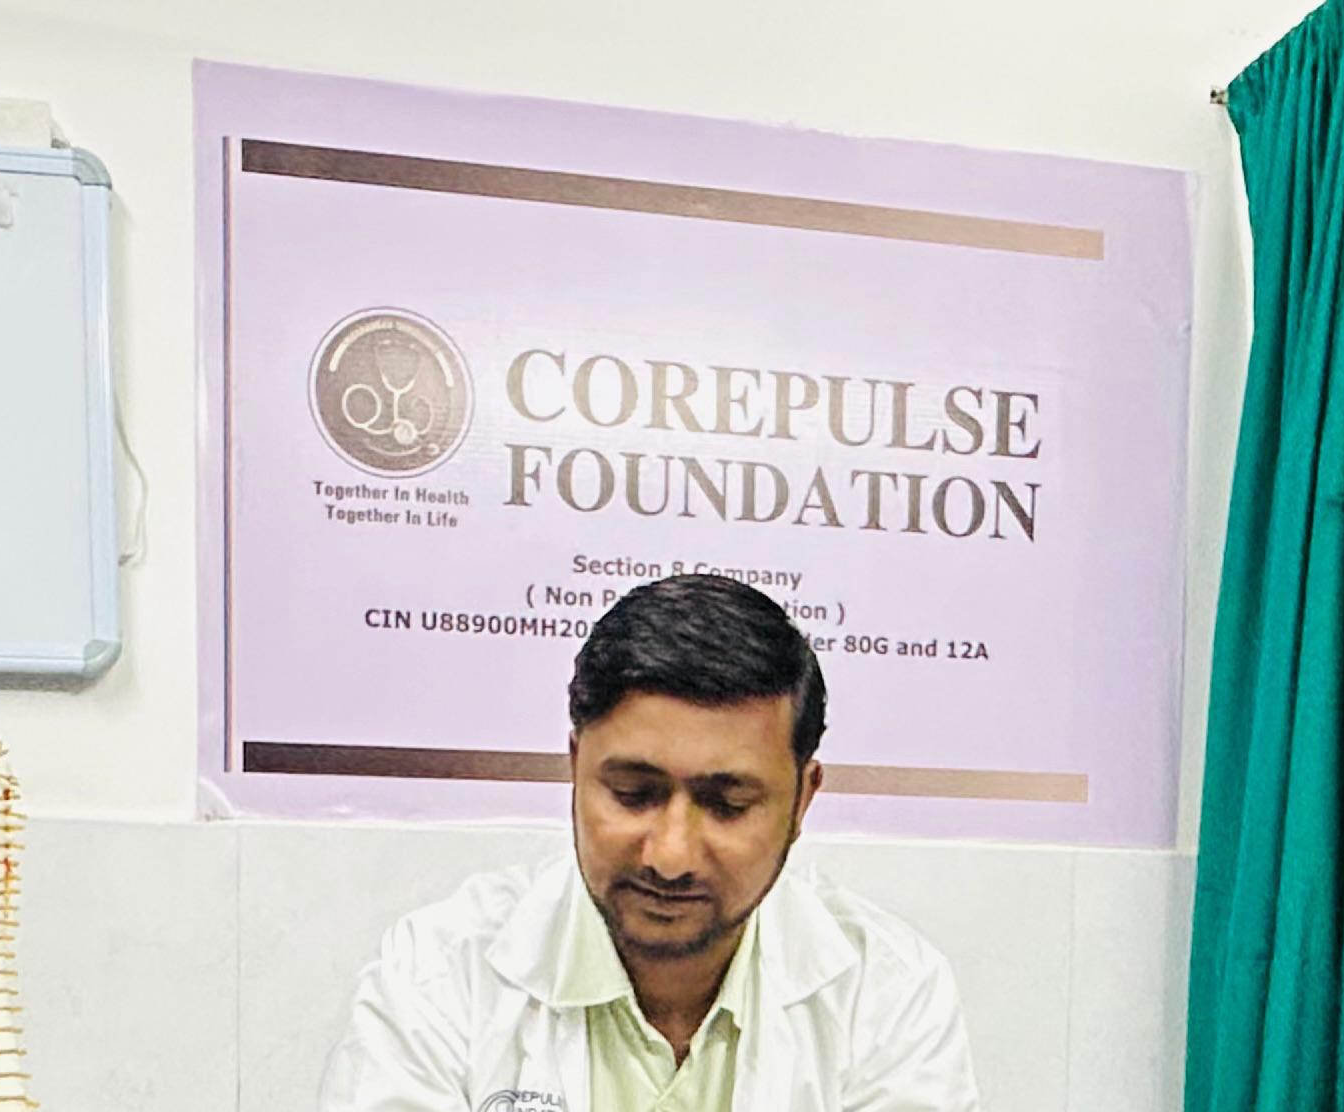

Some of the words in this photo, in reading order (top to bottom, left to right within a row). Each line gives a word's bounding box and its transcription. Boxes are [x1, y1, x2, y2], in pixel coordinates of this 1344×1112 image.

[505, 348, 1042, 459] COREPULSE
[313, 480, 388, 501] Together
[395, 486, 410, 502] In
[415, 487, 470, 506] Health
[502, 443, 1042, 543] FOUNDATION
[325, 504, 401, 525] Together
[406, 509, 421, 525] In
[427, 511, 458, 528] Life
[572, 555, 662, 578] Section
[671, 561, 685, 576] 8
[693, 562, 803, 591] Company
[545, 586, 593, 607] Non
[364, 608, 411, 630] CIN
[421, 611, 592, 639] U88900MH20
[844, 635, 889, 655] 80G
[896, 639, 938, 658] and
[946, 641, 989, 660] 12A
